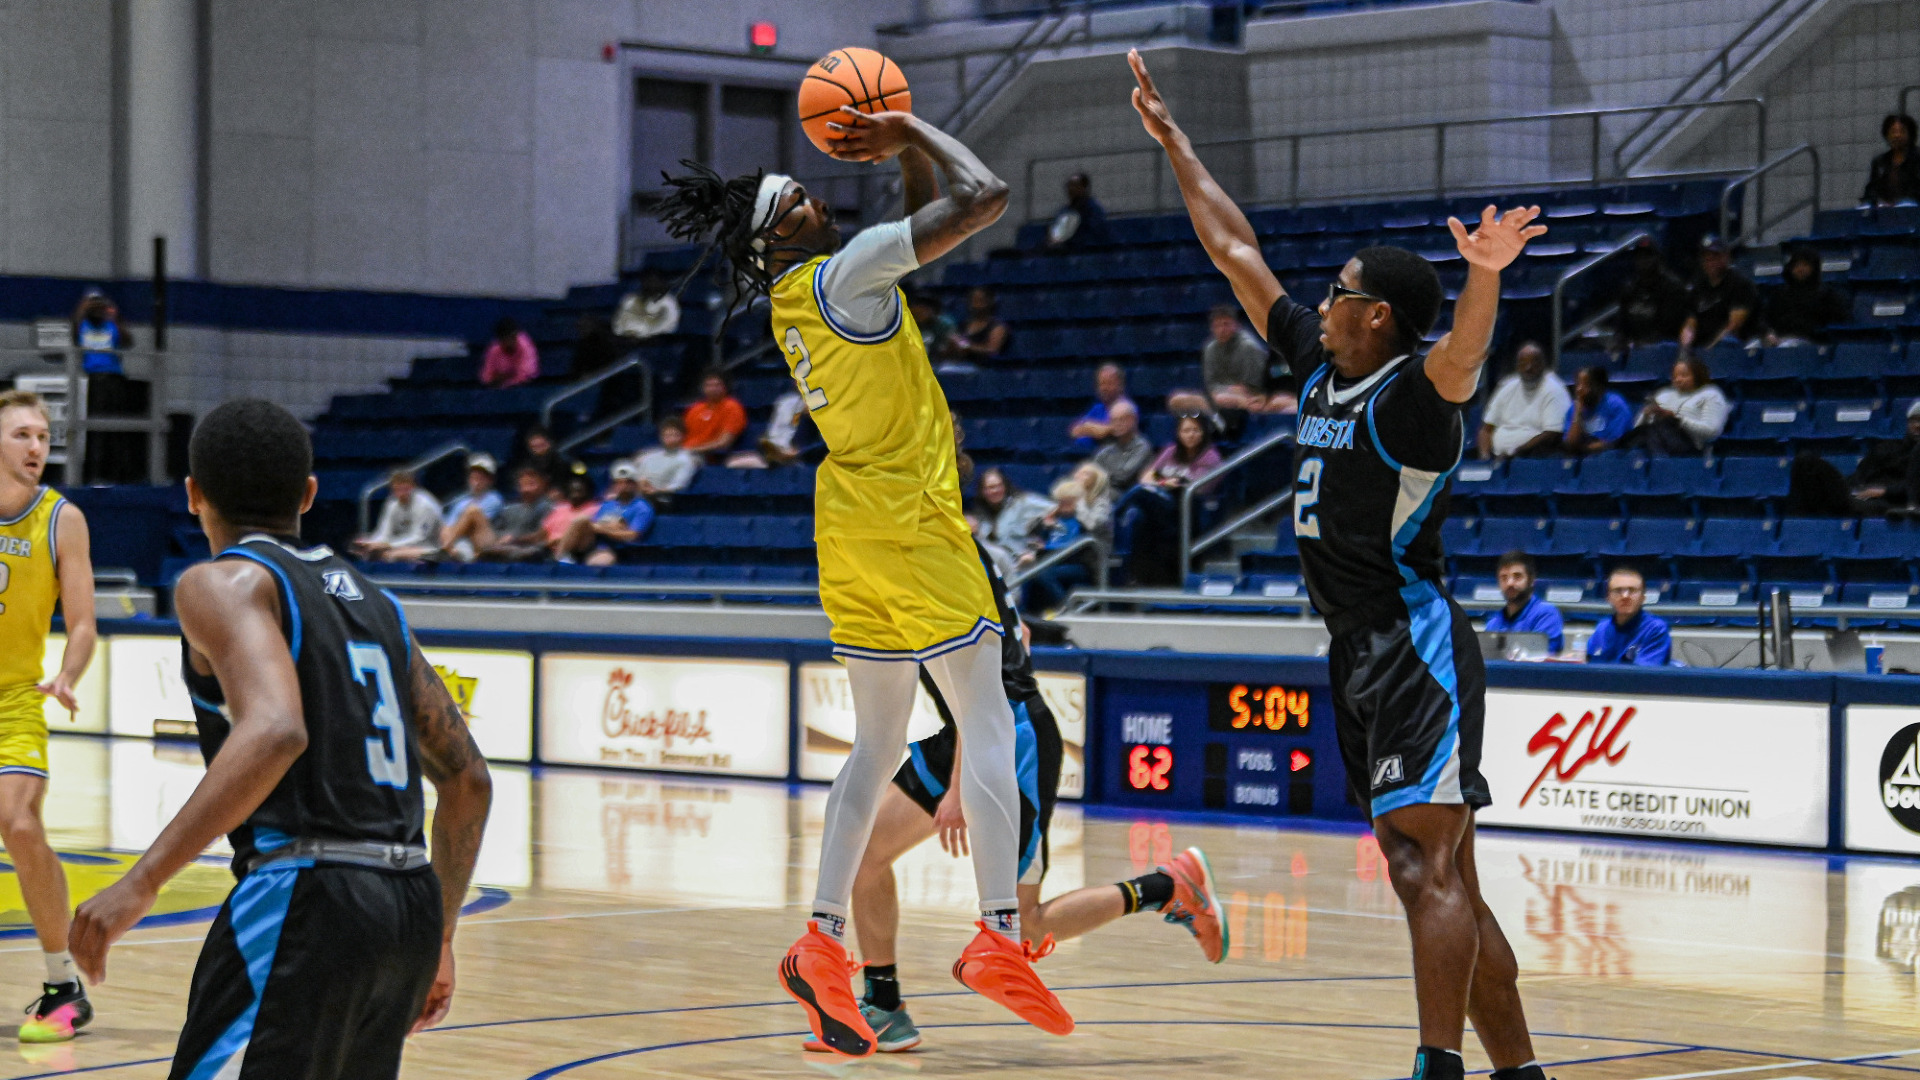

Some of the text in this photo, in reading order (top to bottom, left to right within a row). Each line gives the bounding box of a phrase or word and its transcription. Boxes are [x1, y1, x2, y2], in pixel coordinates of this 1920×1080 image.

[784, 325, 829, 412] 2
[1295, 457, 1324, 539] 2
[346, 640, 409, 791] 3
[1121, 713, 1173, 745] HOME
[1229, 683, 1310, 731] 5:04
[1128, 744, 1173, 791] 62
[1237, 750, 1277, 772] POSS.
[1518, 705, 1638, 809] SCU
[1234, 783, 1279, 806] BONUS
[1538, 786, 1750, 820] STATE CREDIT UNION
[1581, 814, 1706, 833] www.scscu.com
